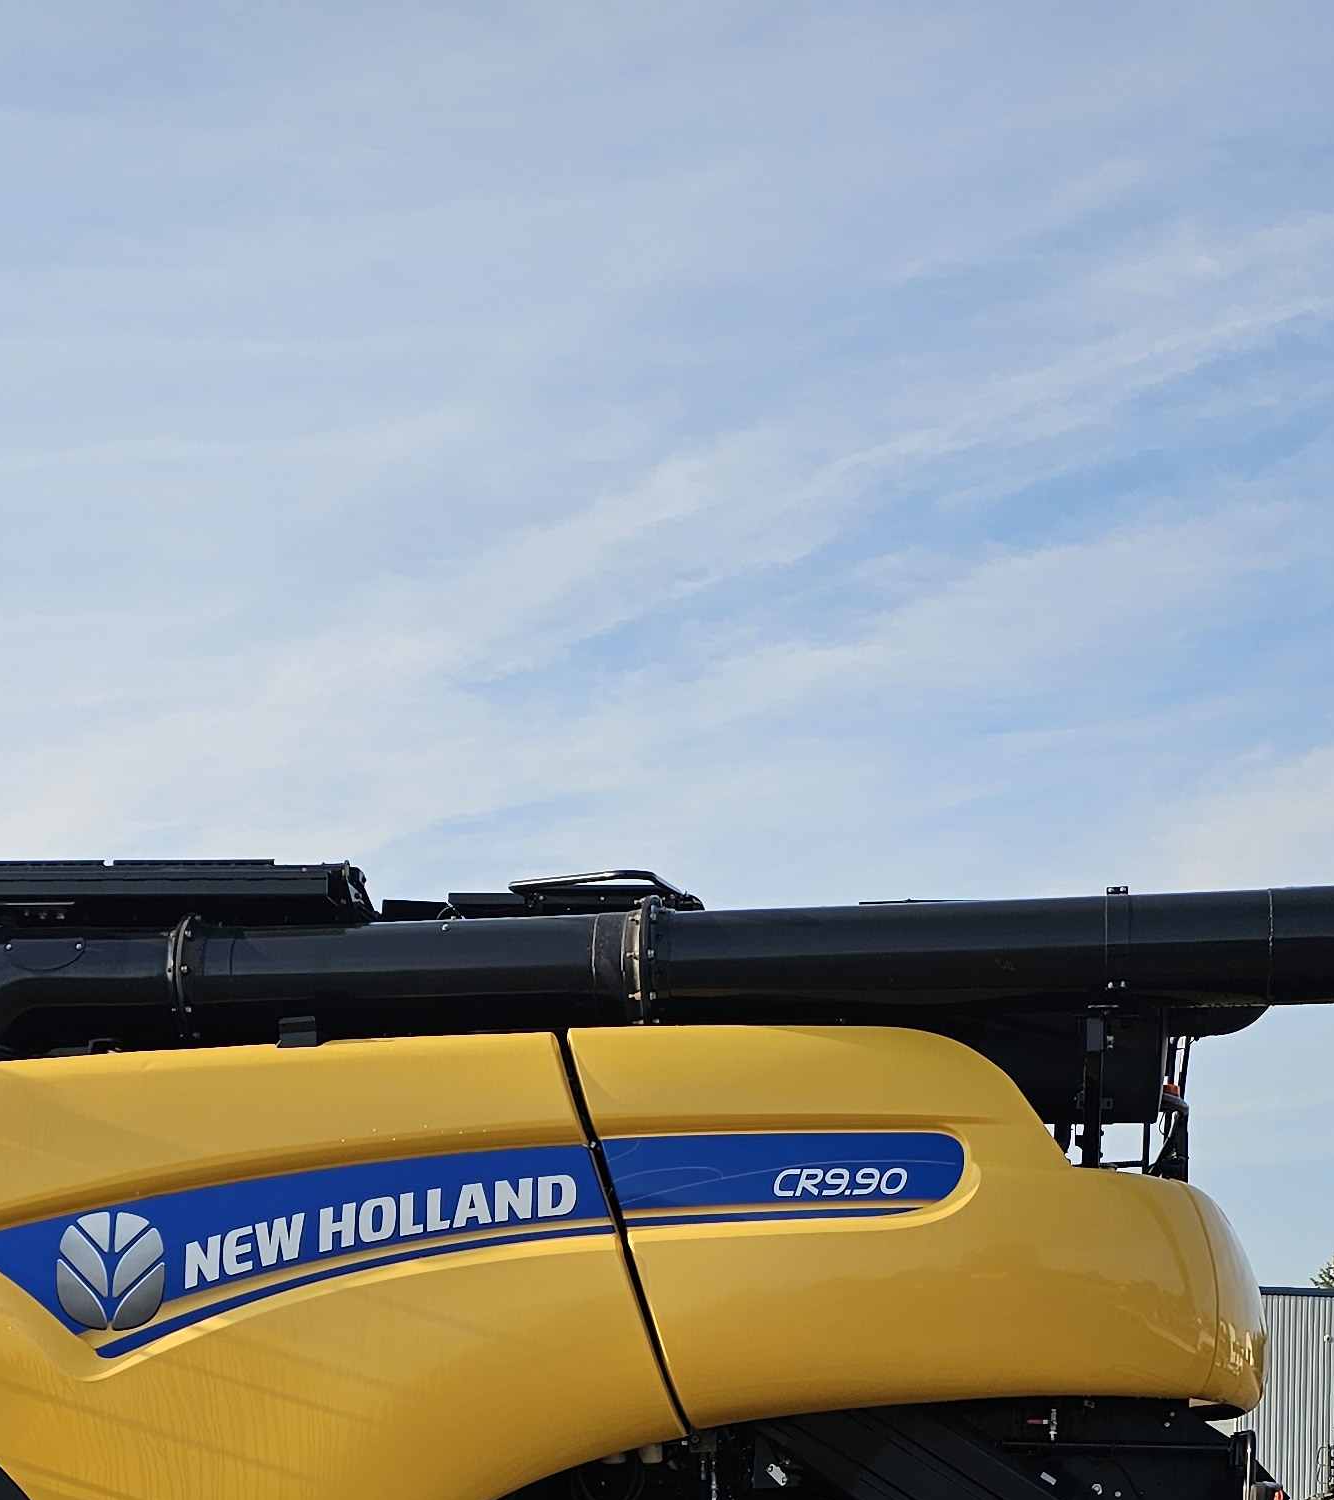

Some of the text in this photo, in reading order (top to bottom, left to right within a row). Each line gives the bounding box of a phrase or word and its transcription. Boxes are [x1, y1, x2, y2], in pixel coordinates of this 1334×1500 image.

[772, 1167, 909, 1198] CR9.90
[184, 1174, 578, 1290] NEW HOLLAND
